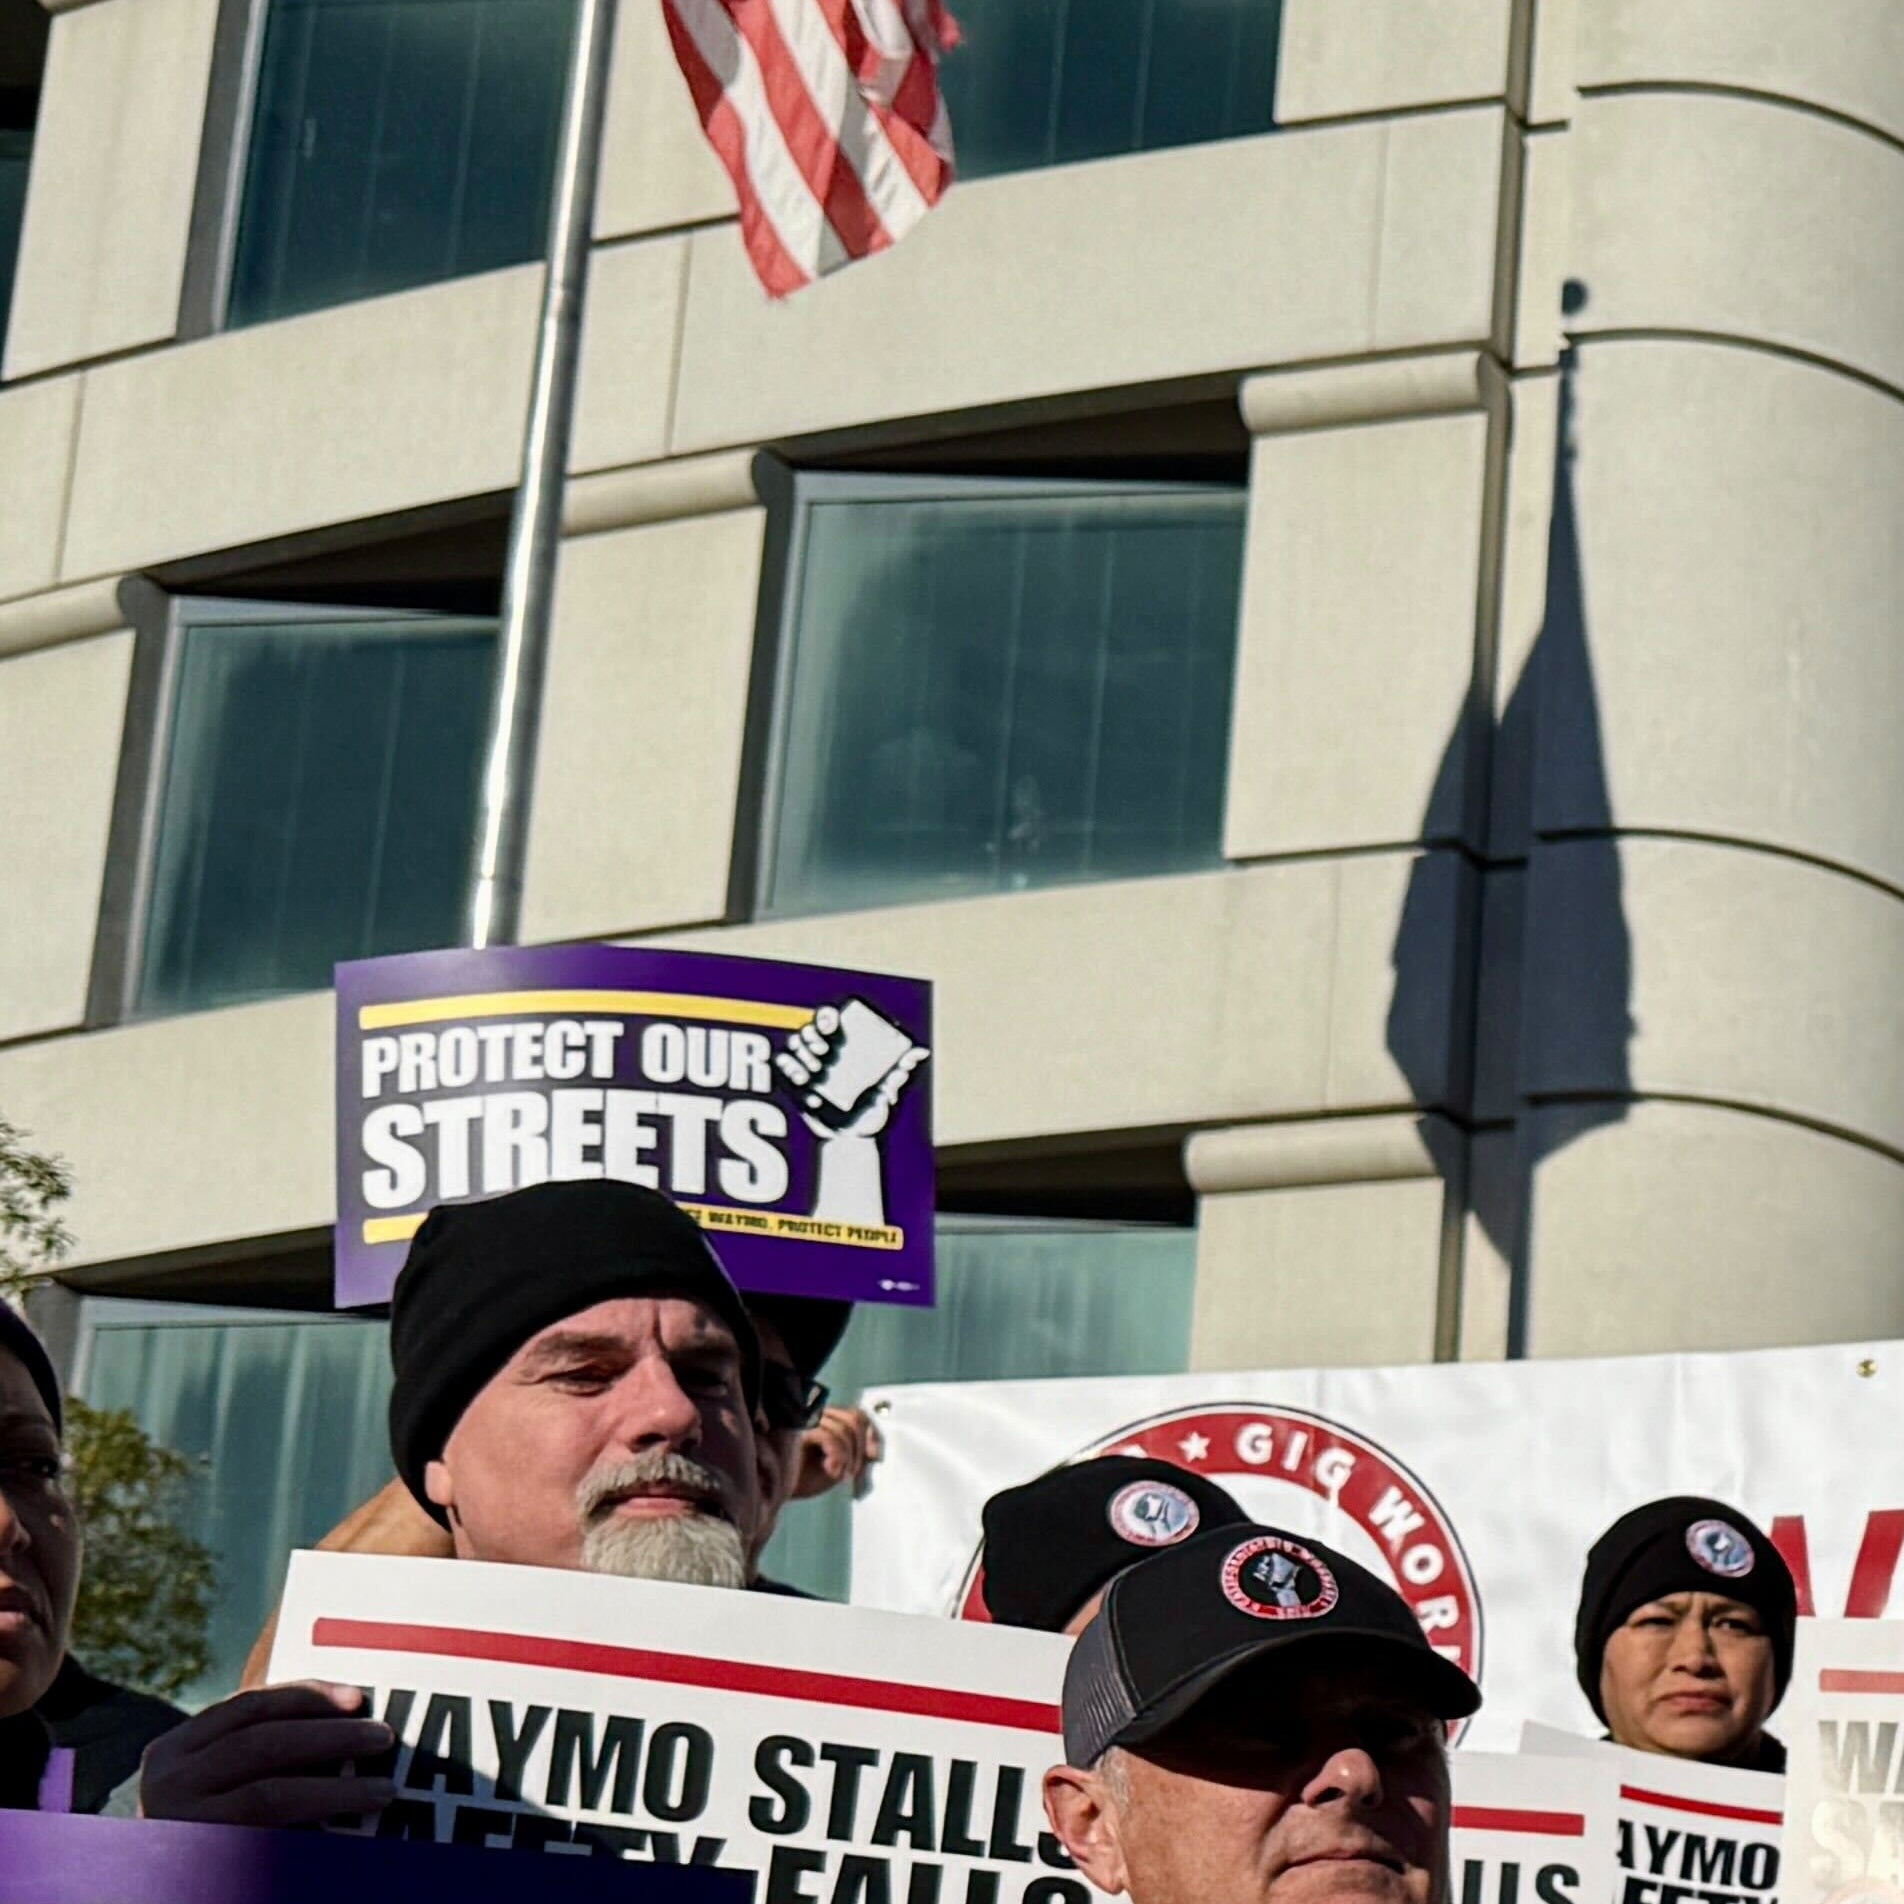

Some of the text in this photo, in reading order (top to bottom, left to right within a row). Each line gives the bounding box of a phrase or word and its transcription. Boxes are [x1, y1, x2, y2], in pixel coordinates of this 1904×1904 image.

[361, 1020, 772, 1098] PROTECT OUR
[362, 1088, 788, 1210] STREETS
[1235, 1422, 1356, 1492] GIG
[749, 1735, 1076, 1870] STALL
